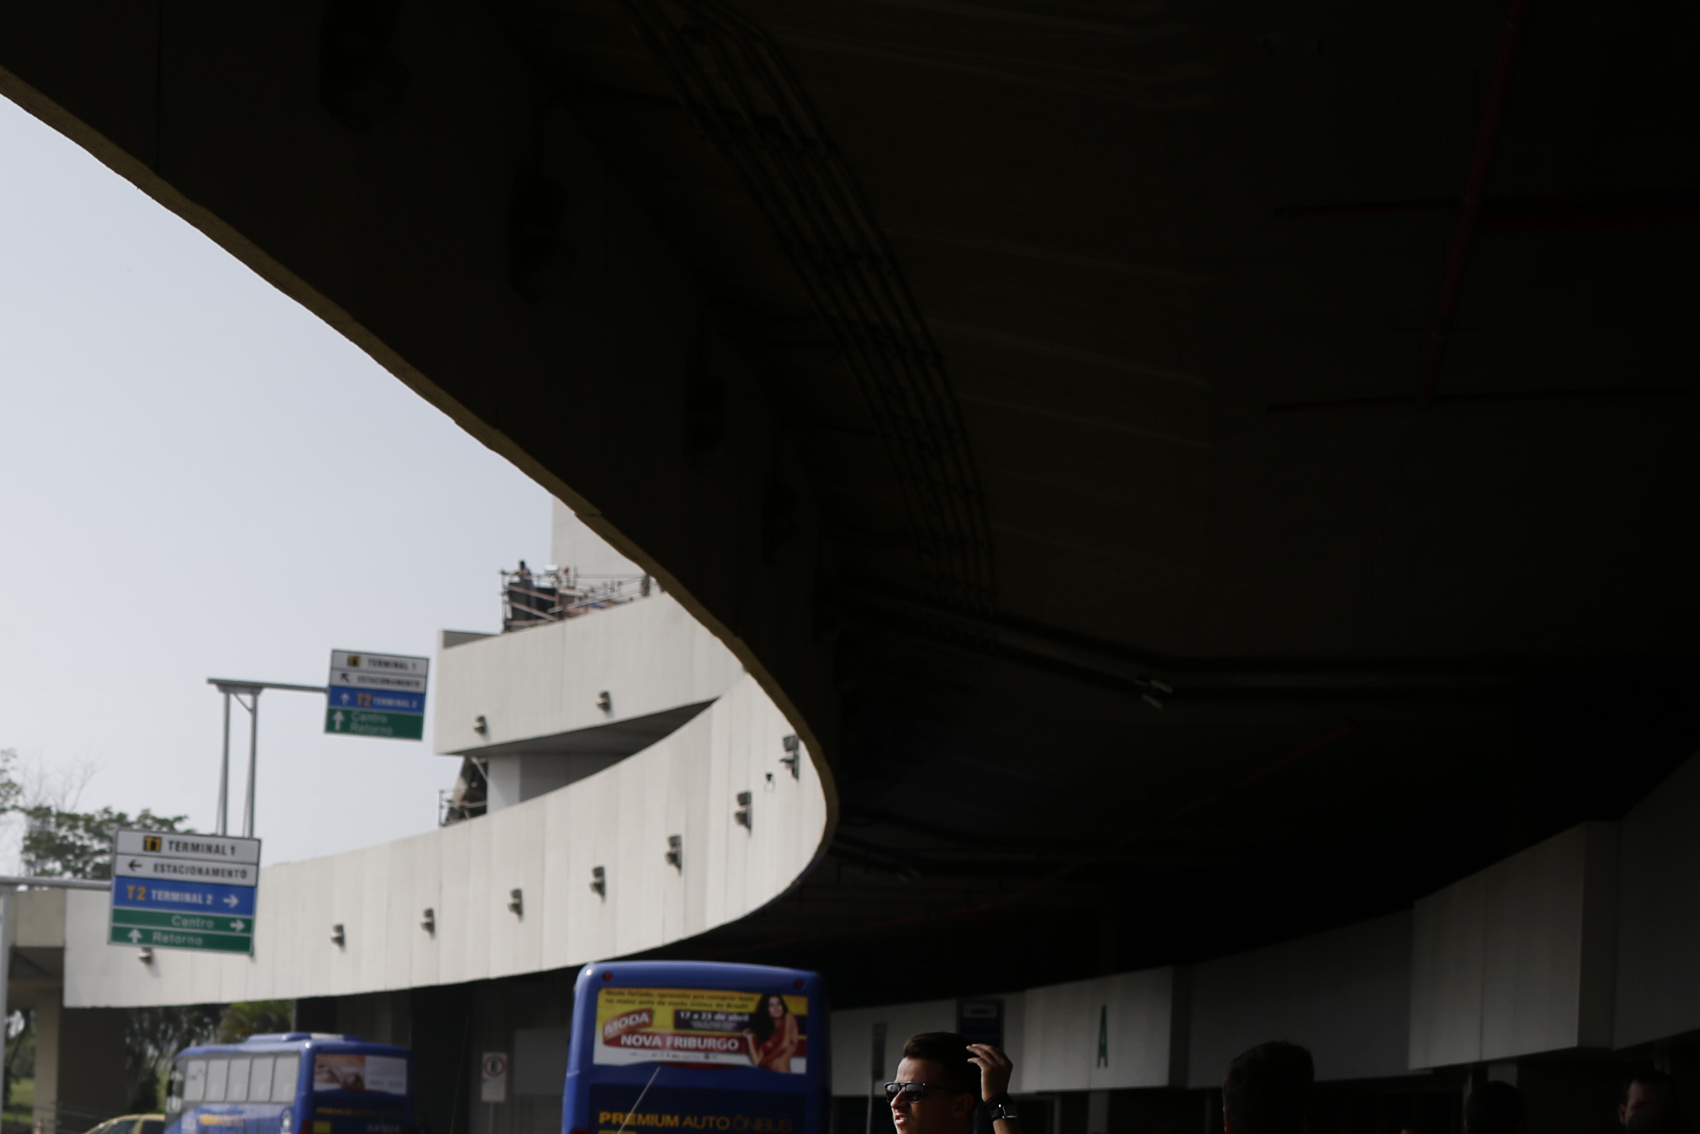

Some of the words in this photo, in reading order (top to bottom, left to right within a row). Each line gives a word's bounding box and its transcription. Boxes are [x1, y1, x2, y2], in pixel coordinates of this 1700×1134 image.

[368, 658, 409, 670] TERMINAL
[357, 675, 420, 687] ESTACIONAMENTO
[357, 693, 372, 707] T2
[373, 696, 410, 708] TERMINAL
[351, 711, 388, 724] Centro
[350, 722, 393, 735] Retorno
[168, 840, 227, 856] TERMINAL
[230, 845, 236, 856] 1
[153, 863, 247, 879] ESTACIONAMENTO
[127, 885, 147, 901] T2
[151, 890, 204, 905] TERMINAL
[205, 894, 214, 905] 2
[171, 915, 215, 929] Centro
[152, 931, 204, 946] Retorno
[604, 1012, 650, 1036] MODA
[621, 1034, 663, 1047] NOVA
[666, 1034, 740, 1052] FRIBURGO
[599, 1111, 679, 1128] PREMIUM
[682, 1115, 731, 1131] AUTO
